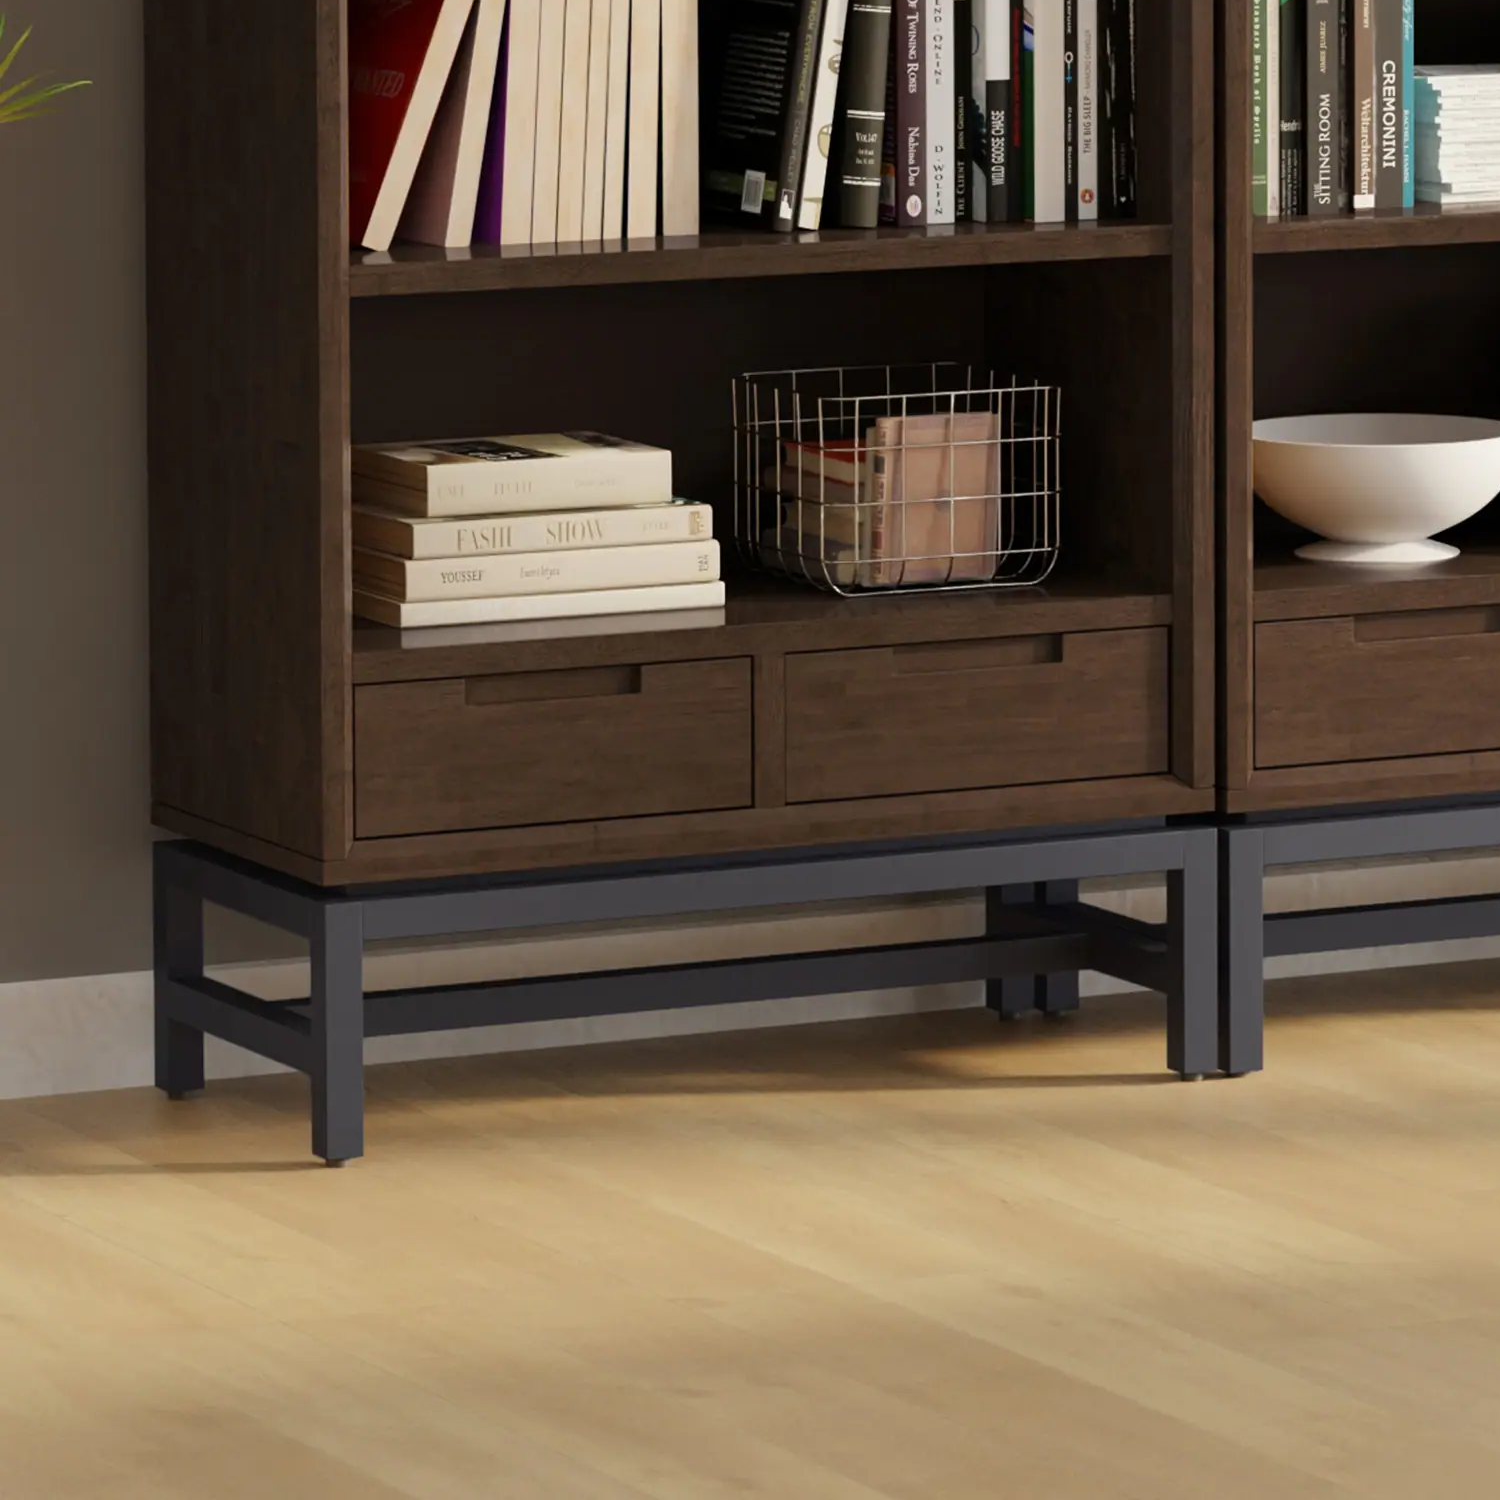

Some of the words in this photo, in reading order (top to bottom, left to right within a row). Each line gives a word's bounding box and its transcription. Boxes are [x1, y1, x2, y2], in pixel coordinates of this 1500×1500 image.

[1083, 96, 1091, 120] SLEEP
[1319, 93, 1330, 142] ROOM
[1382, 60, 1396, 168] CREMONINI
[992, 110, 1005, 135] CHASE
[1083, 122, 1091, 135] BIG
[908, 127, 920, 165] Nabina
[992, 137, 1005, 164] GOOSE
[1083, 138, 1092, 153] THE
[908, 166, 920, 187] Das
[992, 166, 1005, 186] WILD
[1319, 145, 1330, 204] SITTING
[441, 570, 484, 584] YOUSSEF
